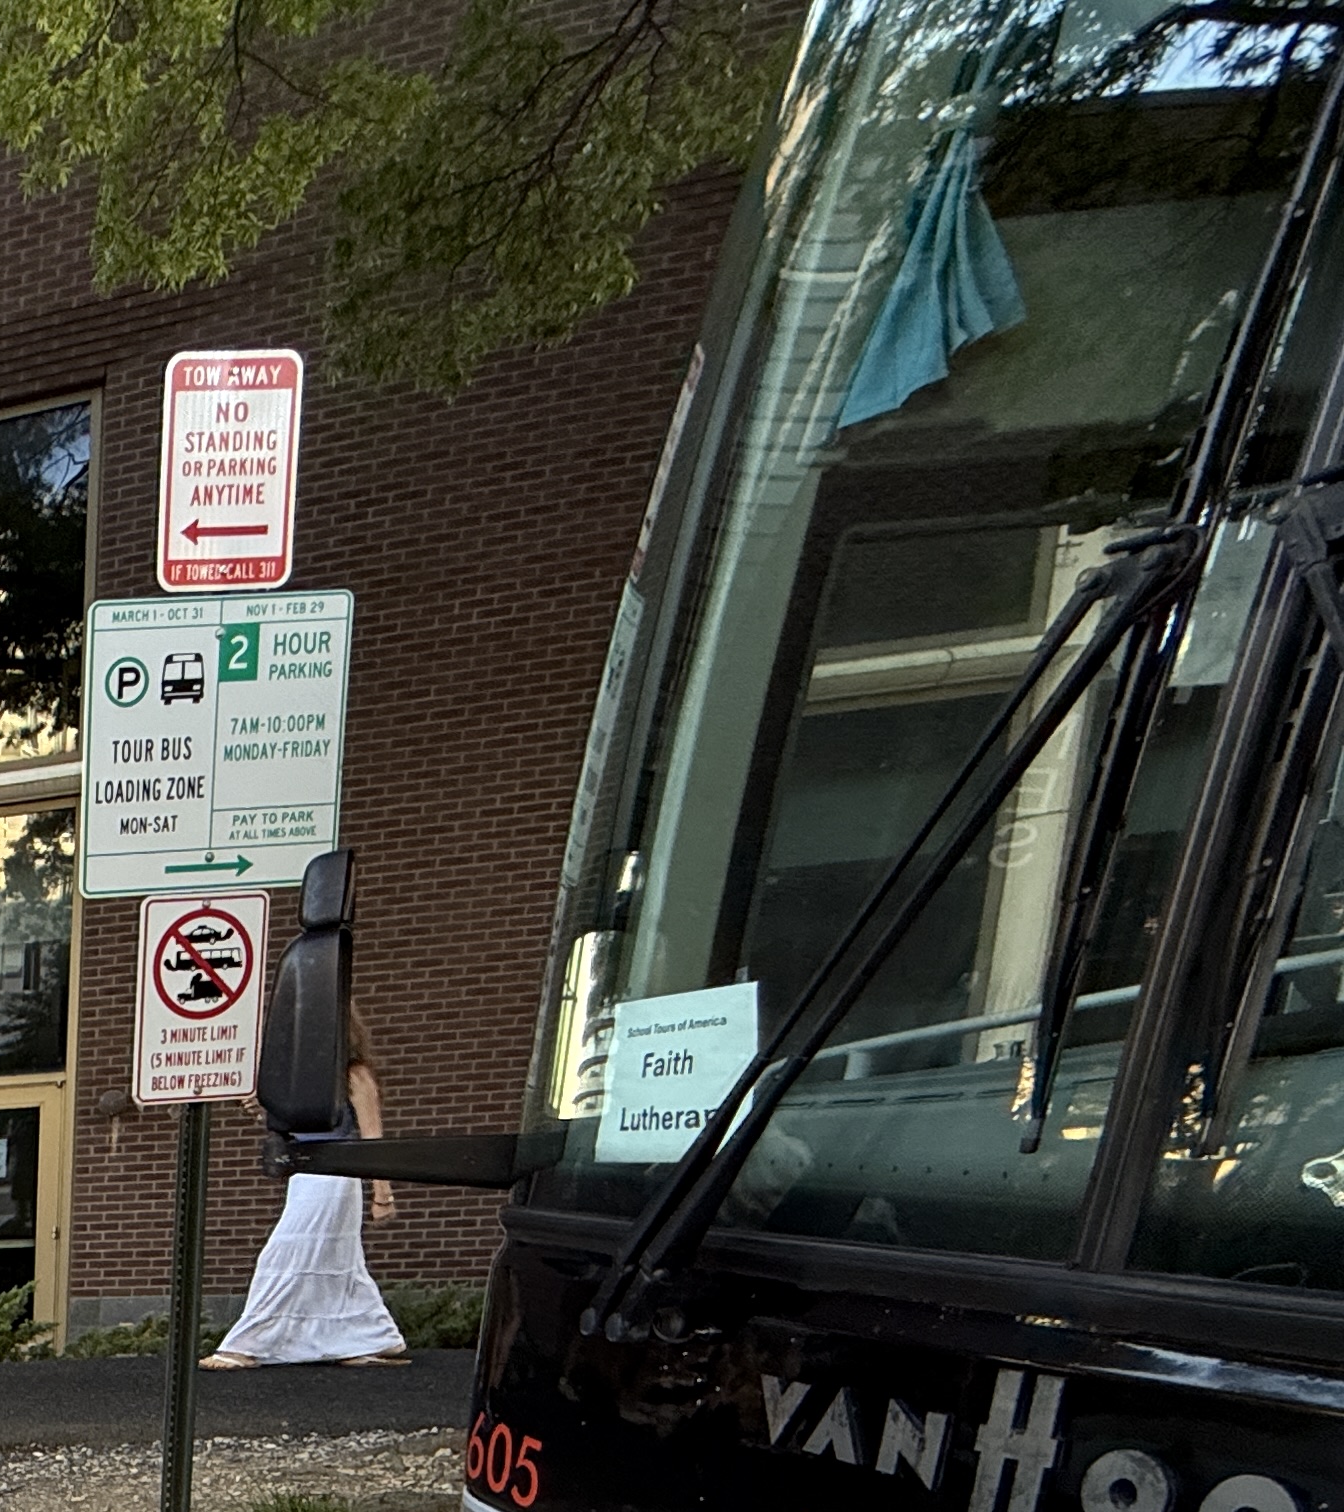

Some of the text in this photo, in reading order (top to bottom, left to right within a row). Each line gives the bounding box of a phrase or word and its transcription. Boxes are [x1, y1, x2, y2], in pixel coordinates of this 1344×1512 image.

[184, 365, 282, 386] TOW AWAY
[215, 402, 249, 423] NO
[185, 430, 278, 453] STANDING
[182, 457, 278, 477] OR PARKING
[190, 483, 265, 507] ANYTIME
[171, 561, 276, 581] IF TOWED CALL 311
[112, 610, 149, 623] MARCH
[167, 609, 189, 621] OCT
[192, 607, 203, 619] 31
[246, 604, 267, 617] NOV
[286, 603, 307, 615] FEB
[310, 601, 325, 613] 29
[228, 636, 248, 670] 2
[273, 631, 331, 656] HOUR
[269, 661, 332, 681] PARKING
[116, 667, 141, 699] P
[230, 714, 325, 735] 7AM-10:00PM
[112, 736, 192, 763] TOUR BUS
[224, 739, 330, 762] MONDAY-FRIDAY
[95, 775, 206, 804] LOADING ZONE
[120, 814, 178, 835] MON-SAT
[232, 810, 314, 826] PAY TO PARK
[229, 825, 317, 840] AT ALL TIMES ABOVE
[160, 1025, 238, 1044] 3 MINUTE LIMIT
[627, 1014, 727, 1038] School Tours of America
[150, 1047, 246, 1069] (5 MINUTE LIMIT IF
[642, 1048, 693, 1078] Faith
[152, 1070, 242, 1091] BELOW FREEZING)
[467, 1411, 543, 1509] 605
